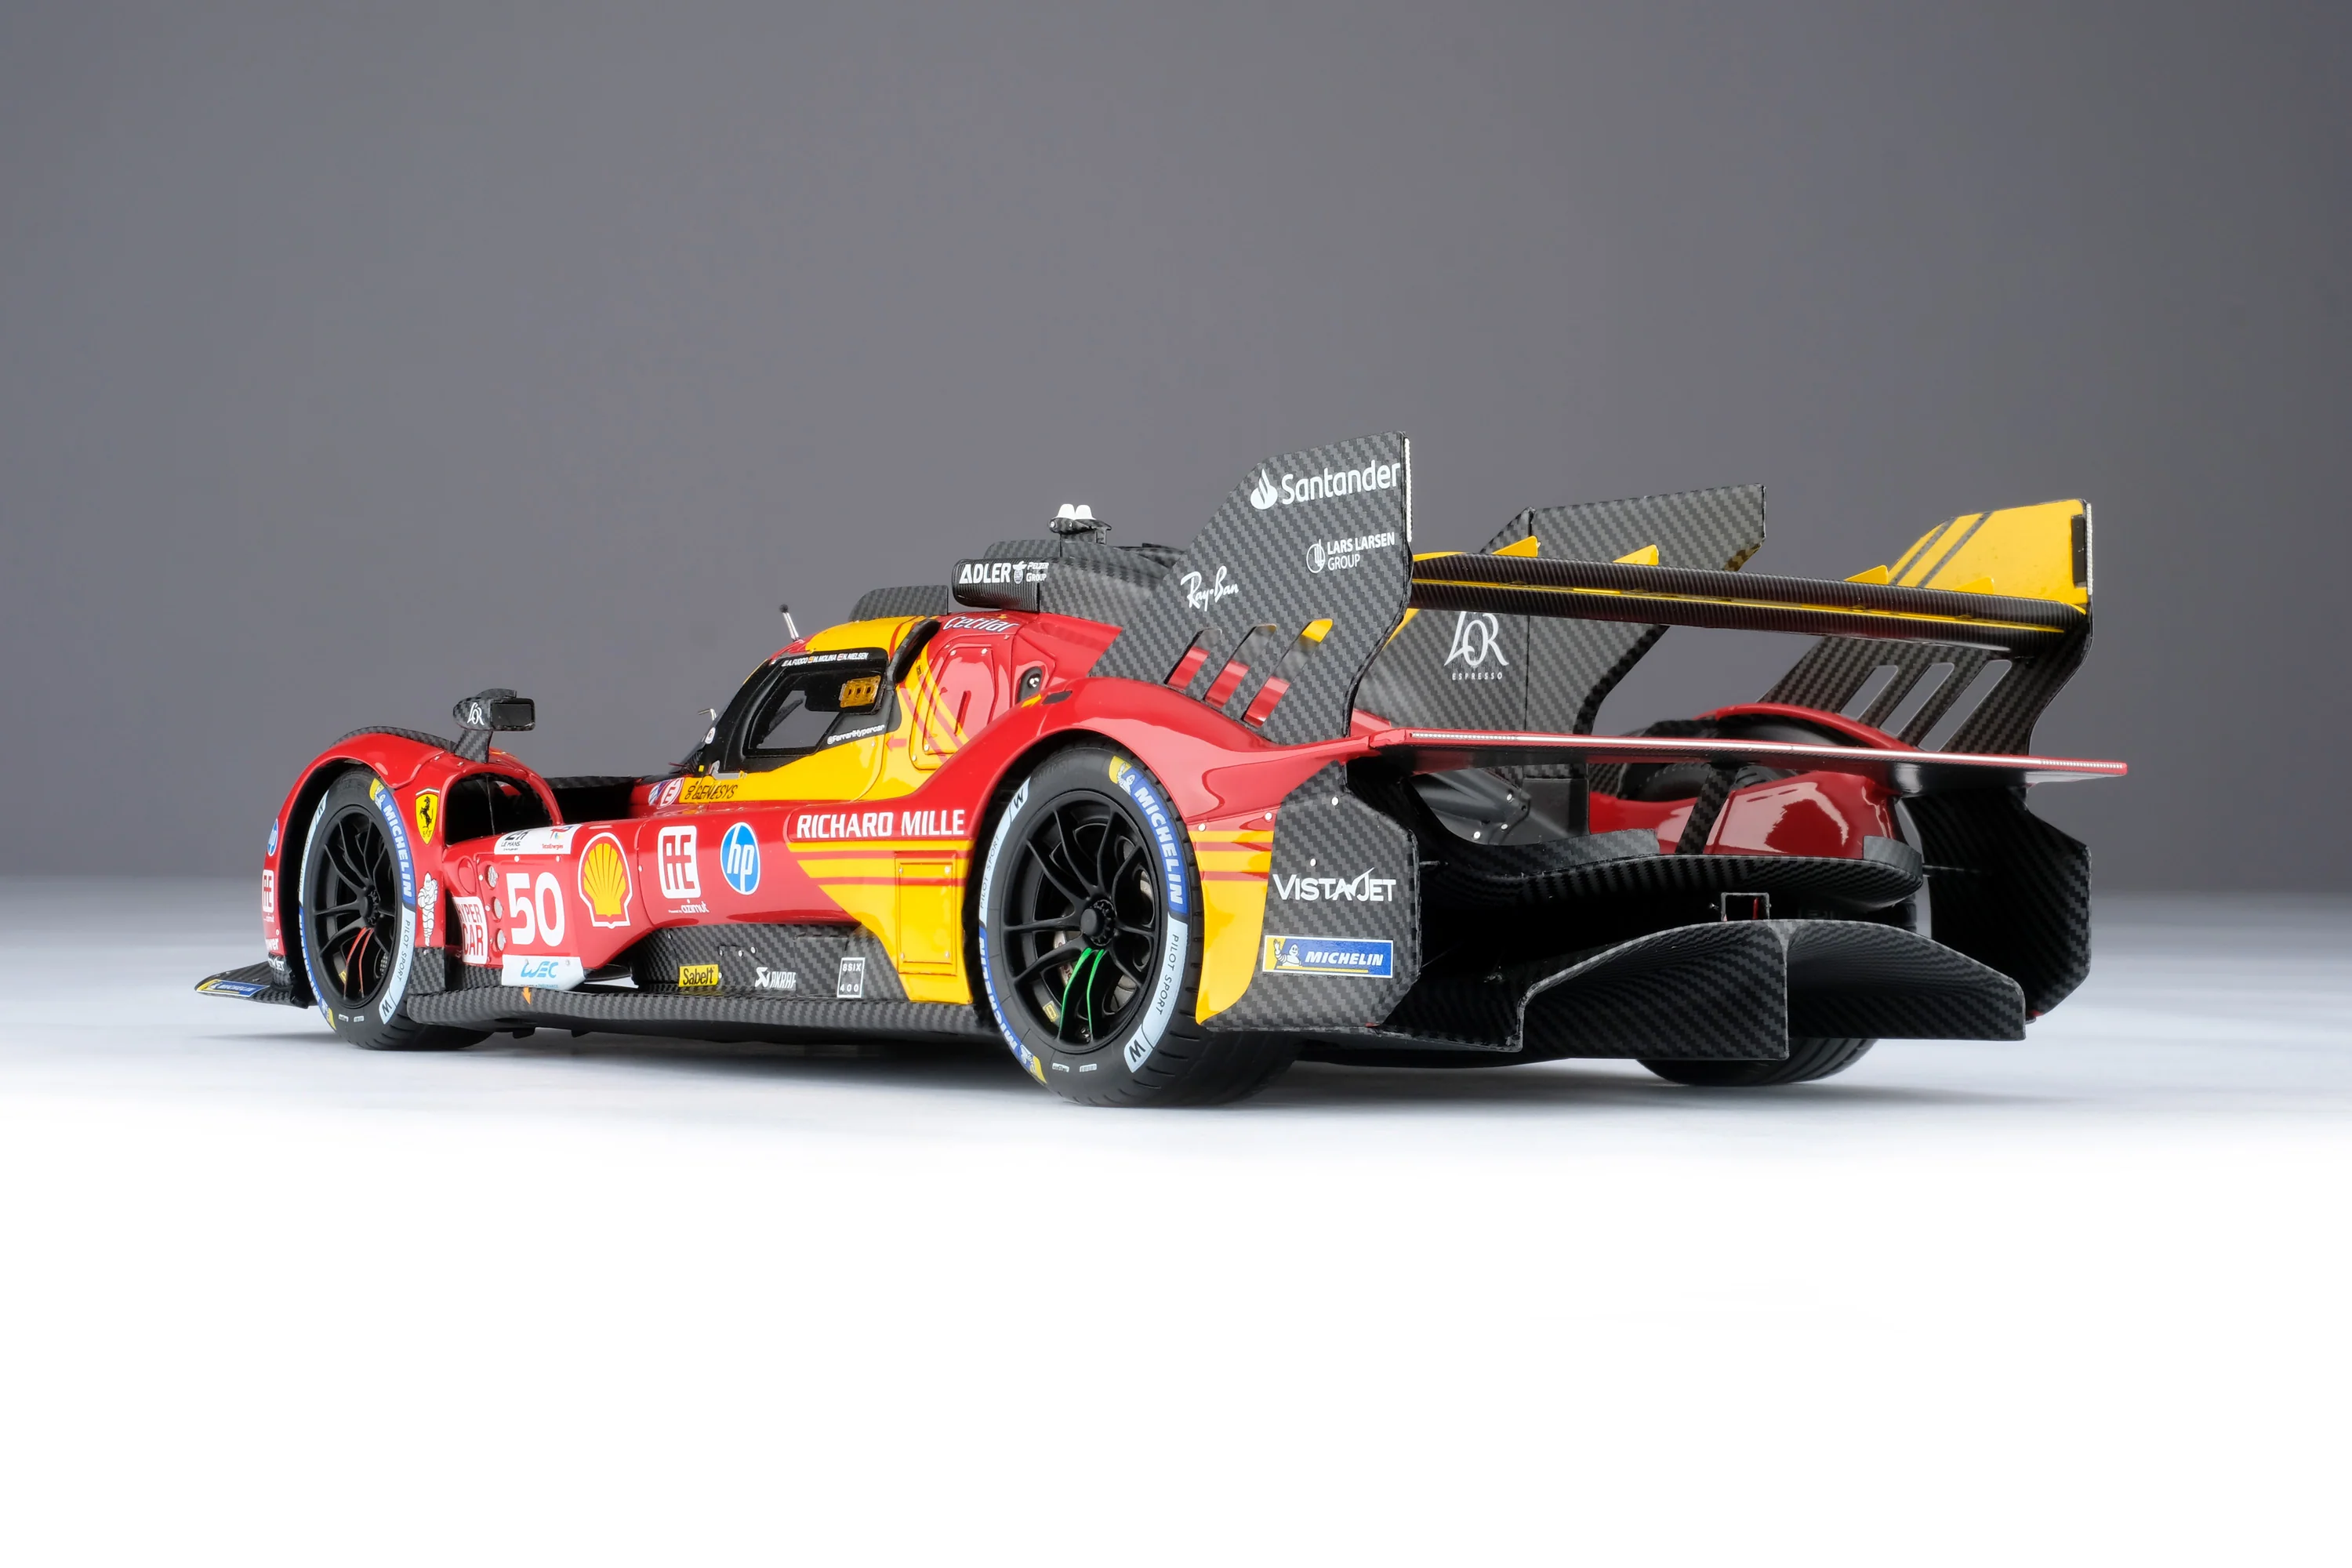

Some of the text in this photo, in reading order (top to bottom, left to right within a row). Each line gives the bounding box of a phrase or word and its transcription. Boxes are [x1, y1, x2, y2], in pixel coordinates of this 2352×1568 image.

[1281, 459, 1401, 505] Santander
[1327, 532, 1396, 555] LARS LARSEN
[1327, 554, 1360, 571] GROUP
[959, 563, 1011, 584] ADLER
[942, 615, 1020, 632] Cetilar
[1452, 672, 1503, 681] ESPRESSO
[827, 724, 885, 745] @FerrariHypercar
[691, 784, 738, 800] GENESYS
[797, 809, 965, 839] RICHARD MILLE
[383, 804, 412, 898] MICHELIN
[986, 835, 1000, 872] SPORT
[1134, 786, 1183, 905] MICHELIN
[726, 824, 755, 893] hp
[1272, 866, 1396, 902] VISTAJET
[457, 903, 482, 924] HYPER
[506, 871, 564, 947] 50
[681, 898, 710, 913] azimut
[463, 924, 484, 956] CAR
[397, 953, 408, 982] SPORT
[520, 960, 558, 978] WEC
[843, 963, 862, 972] 8SIX
[1305, 951, 1384, 966] MICHELIN
[683, 966, 714, 985] Sabelt
[1156, 934, 1179, 1015] PILOT SPORT
[840, 984, 859, 993] 400
[381, 1000, 393, 1017] W
[1128, 1039, 1146, 1063] W
